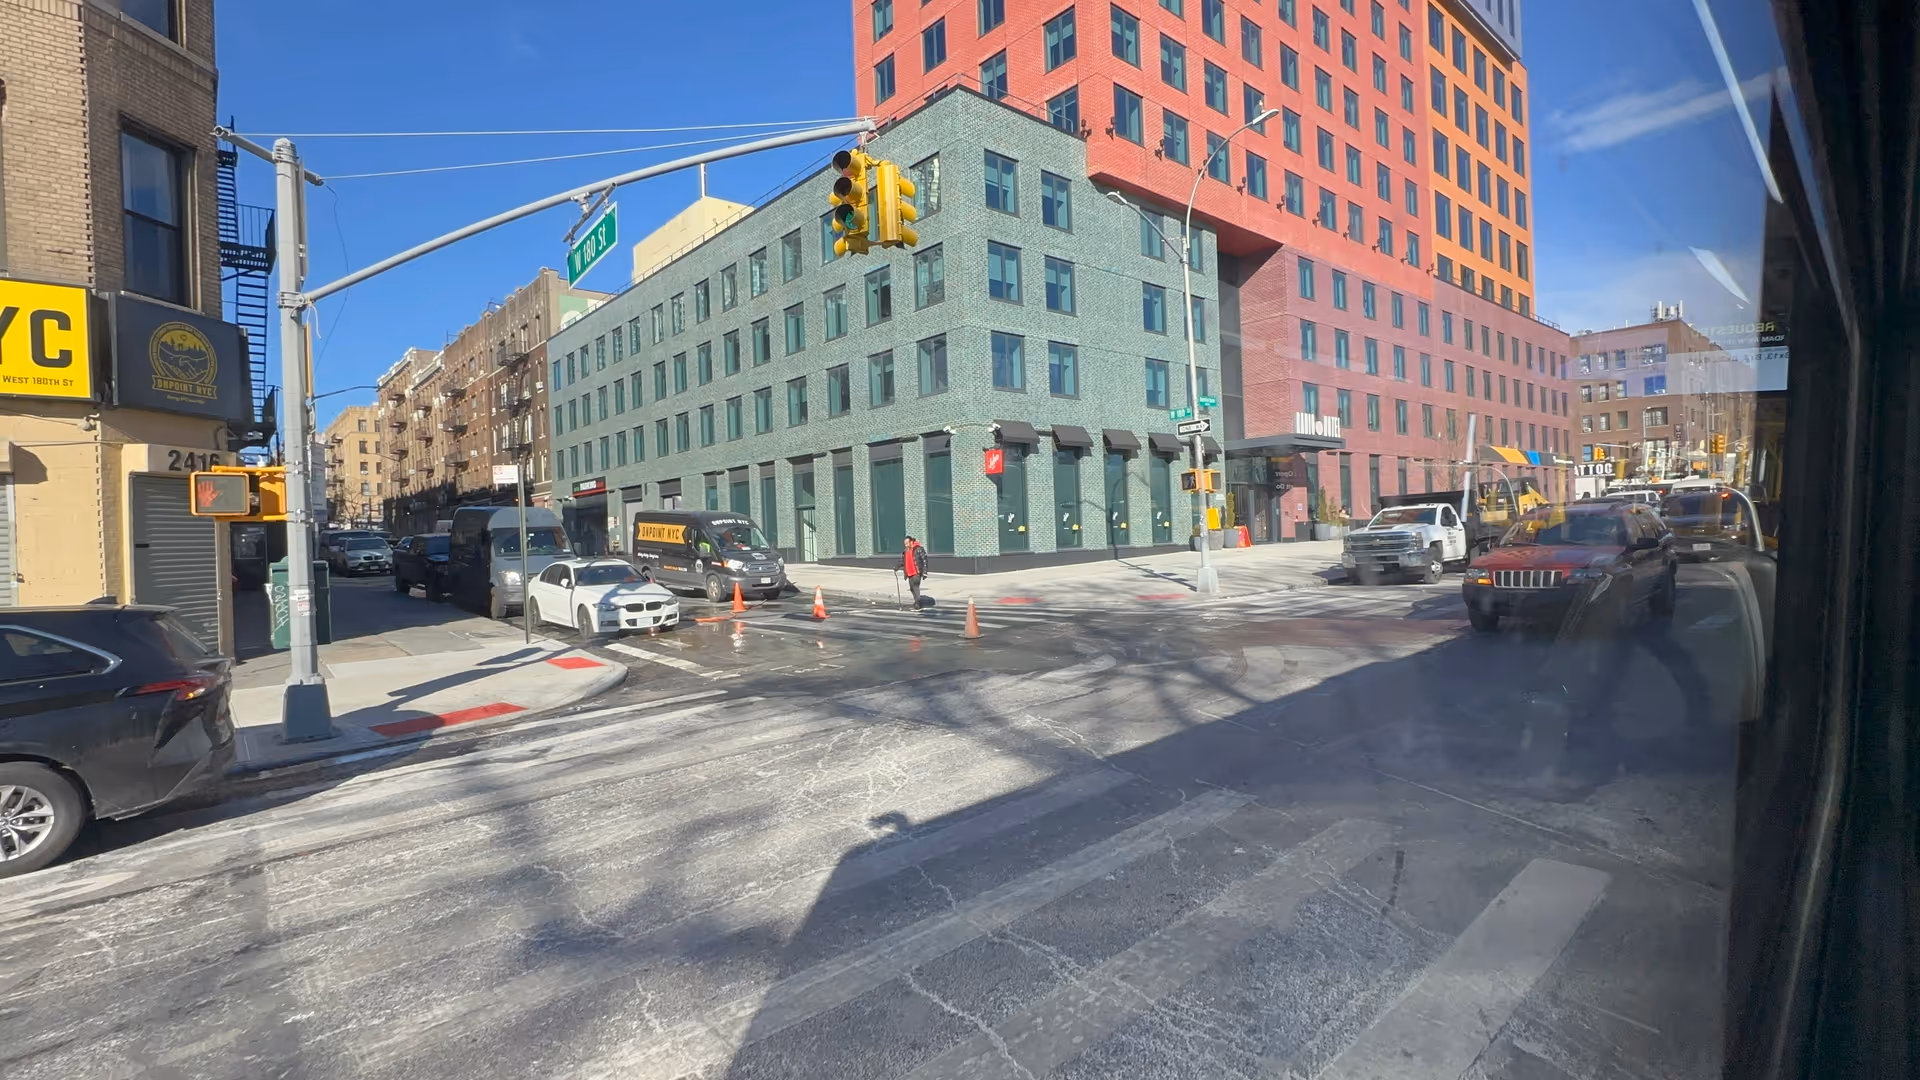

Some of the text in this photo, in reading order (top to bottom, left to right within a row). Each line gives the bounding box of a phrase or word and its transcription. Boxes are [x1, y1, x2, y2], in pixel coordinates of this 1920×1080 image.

[574, 223, 607, 273] W 180 St
[32, 377, 60, 386] 180TH
[157, 378, 213, 396] ONPOINT NYC
[168, 449, 220, 472] 2416
[712, 518, 736, 526] ONPOINT
[642, 526, 680, 540] ONPOINT NYC
